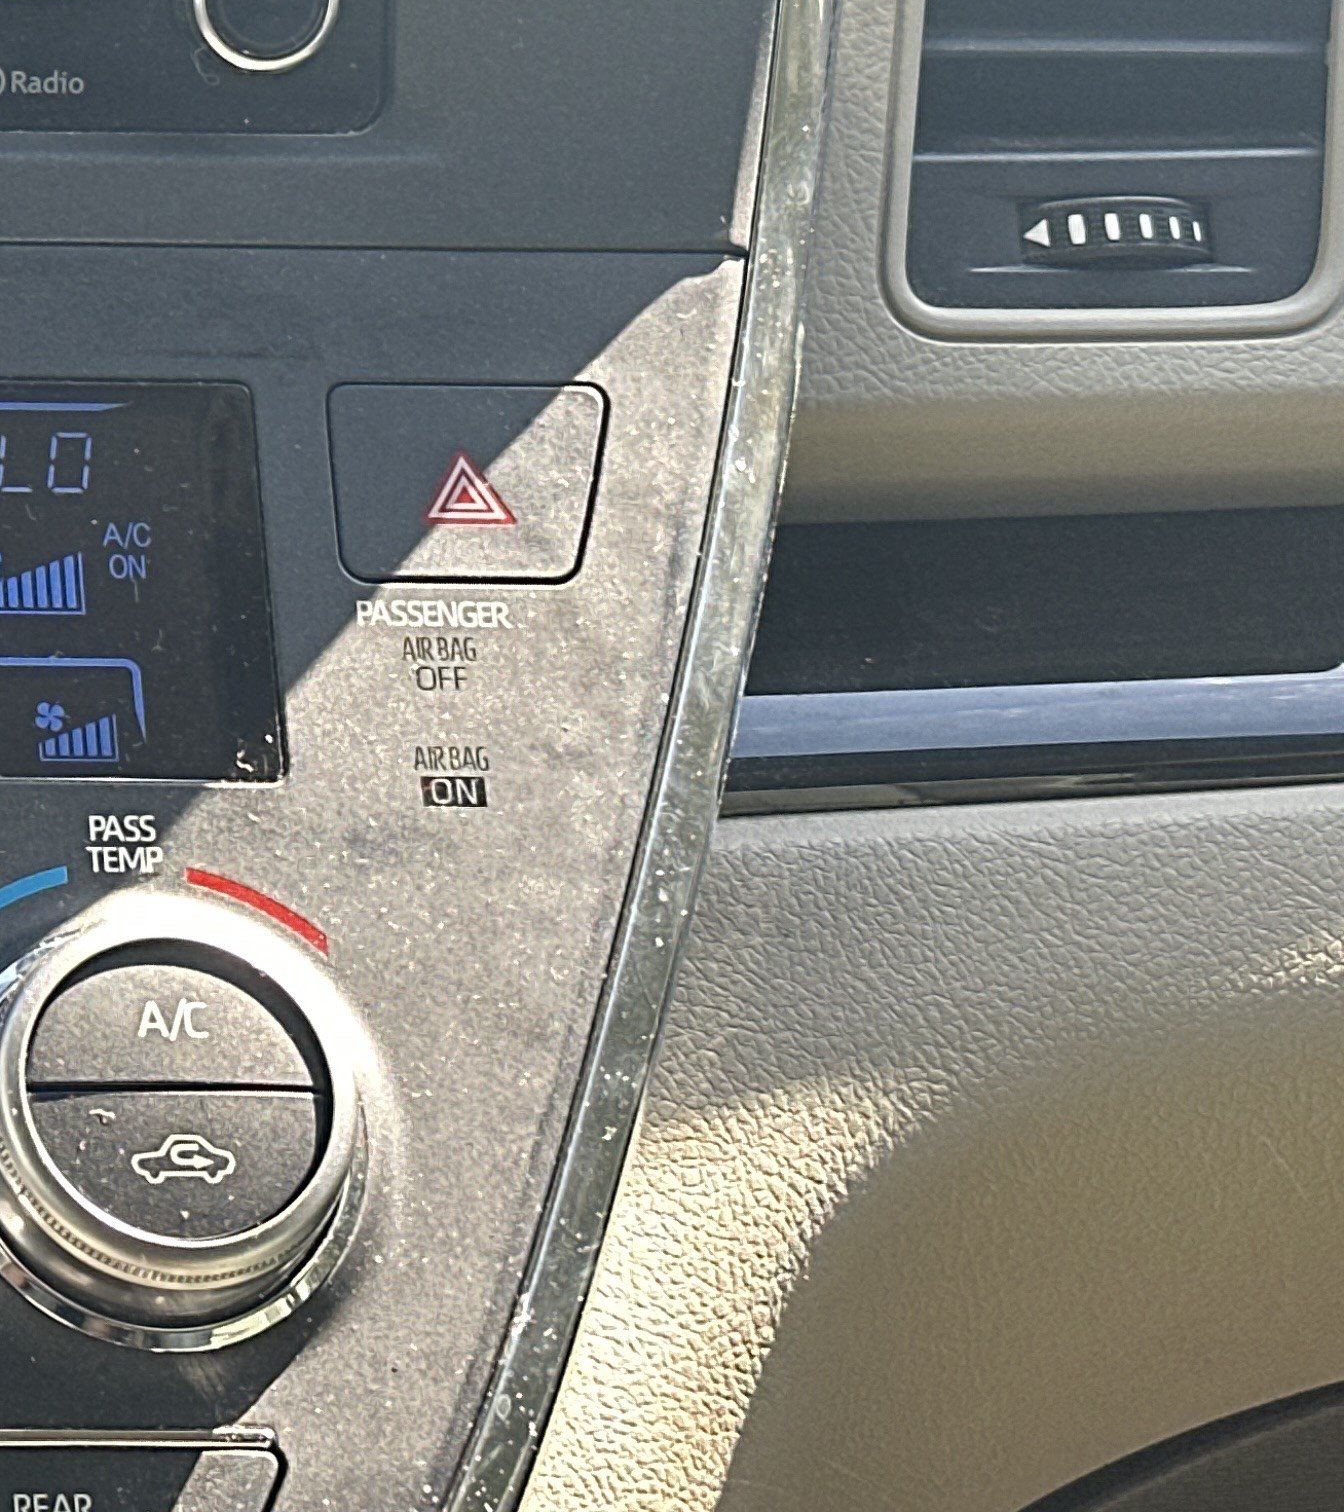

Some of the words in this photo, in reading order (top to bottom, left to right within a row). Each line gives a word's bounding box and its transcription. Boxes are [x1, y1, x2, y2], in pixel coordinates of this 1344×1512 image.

[11, 69, 85, 95] Radio
[102, 522, 152, 549] A/C
[109, 554, 148, 580] ON
[356, 599, 512, 629] PASSENGER
[416, 665, 468, 691] OFF
[430, 777, 480, 805] ON
[88, 815, 157, 842] PASS
[85, 846, 164, 874] TEMP
[137, 998, 210, 1042] A/C
